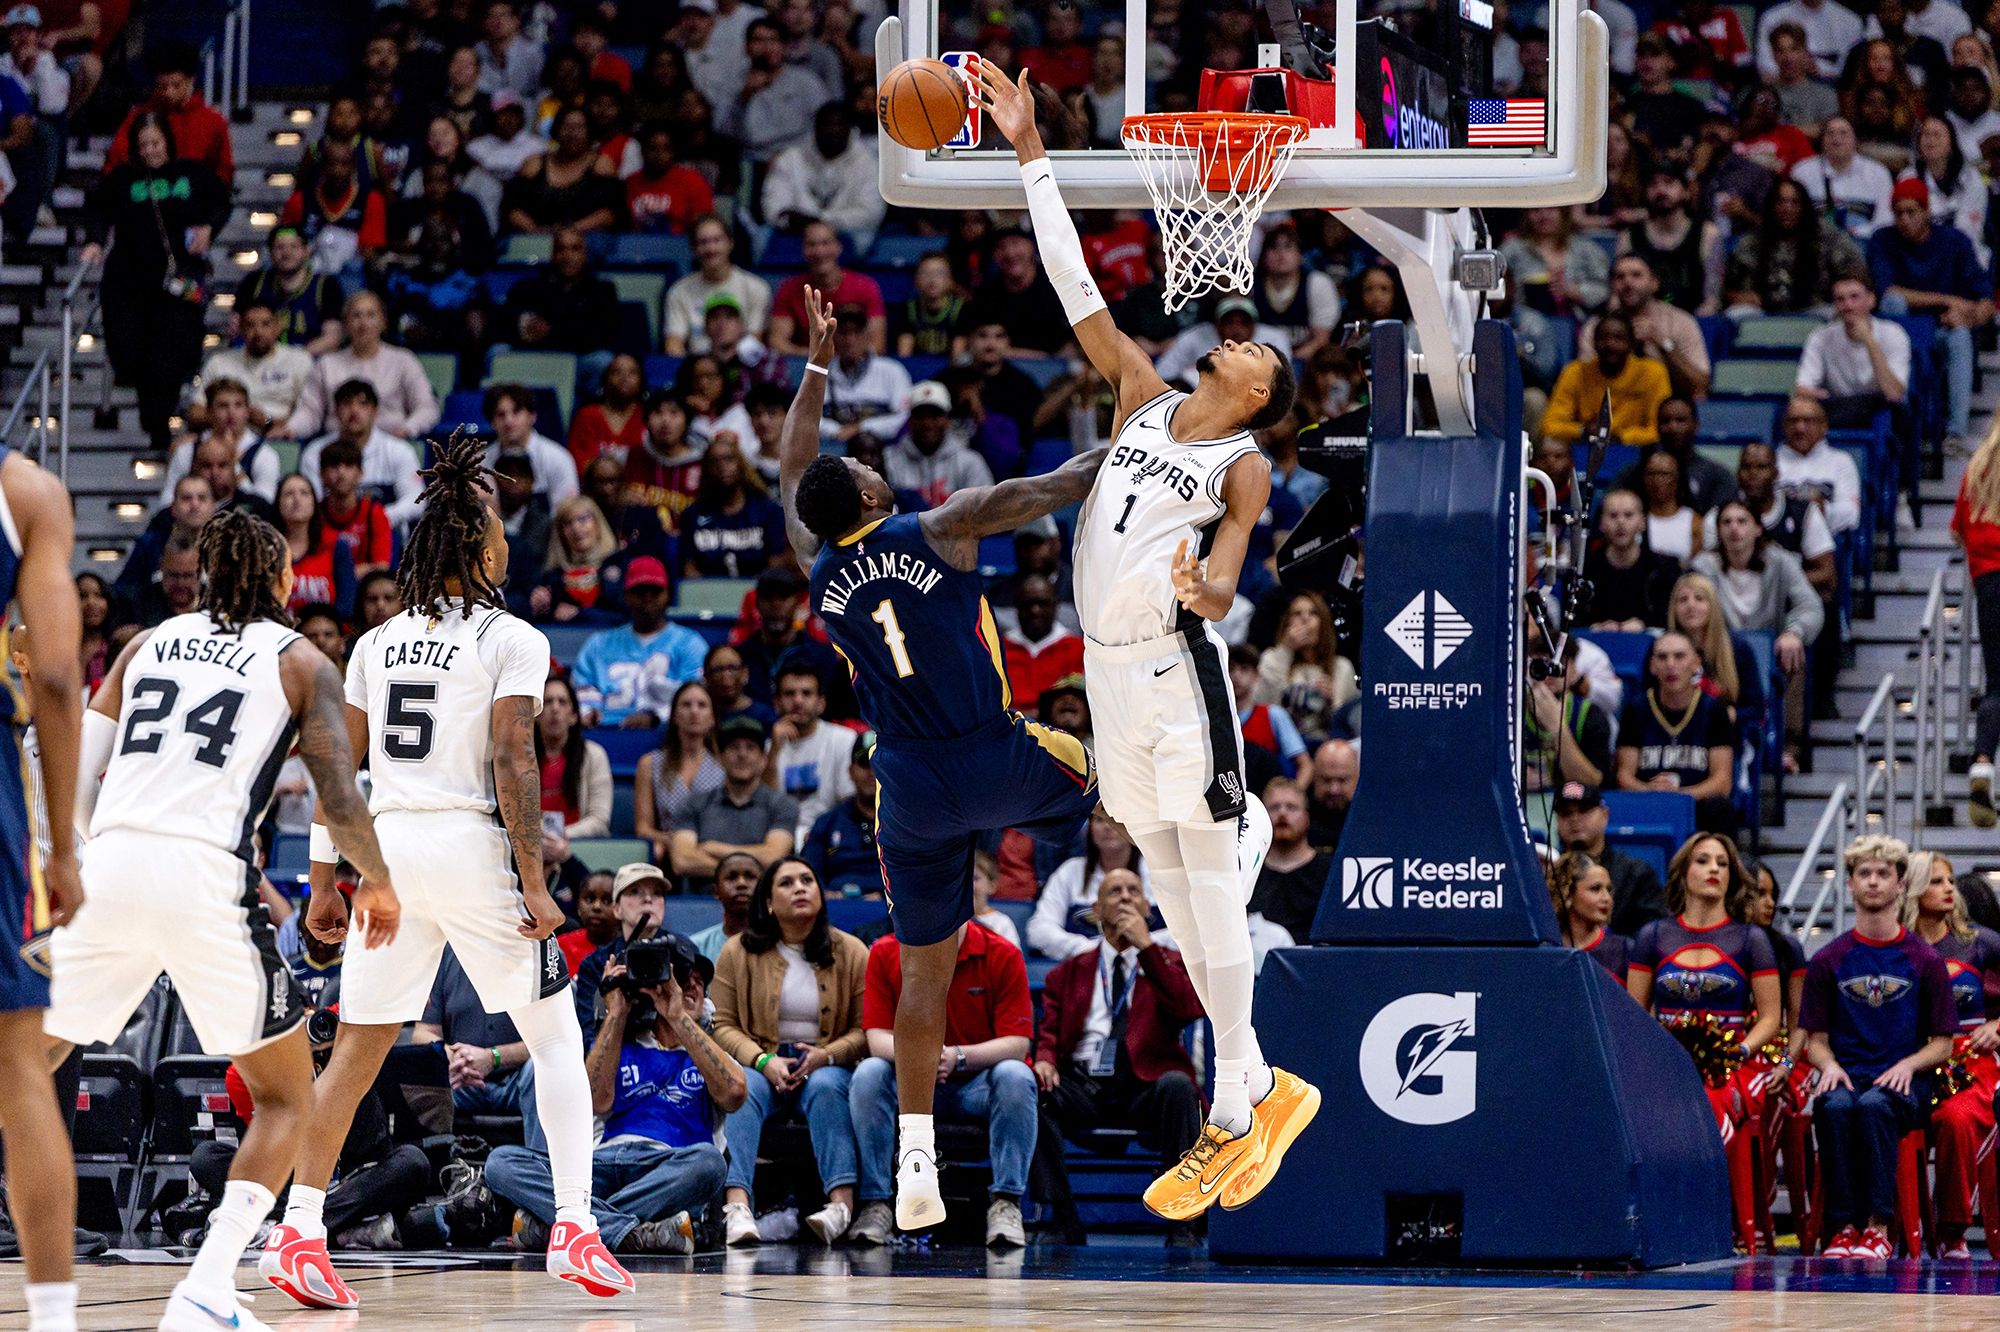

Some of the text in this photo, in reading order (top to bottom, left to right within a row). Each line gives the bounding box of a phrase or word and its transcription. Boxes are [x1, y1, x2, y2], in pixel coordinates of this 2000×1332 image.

[1111, 446, 1199, 502] SPURS
[1112, 493, 1139, 535] 1
[821, 552, 943, 616] WILLIAMSON
[155, 638, 256, 677] VASSELL
[384, 640, 460, 671] CASTLE
[871, 598, 914, 679] 1
[1374, 683, 1482, 696] AMERICAN
[1388, 697, 1468, 709] SAFETY
[119, 675, 248, 770] 24
[382, 681, 438, 762] 5
[1403, 856, 1506, 881] Keesler
[1403, 884, 1503, 909] Federal
[620, 1064, 640, 1087] 21
[1359, 991, 1477, 1126] G
